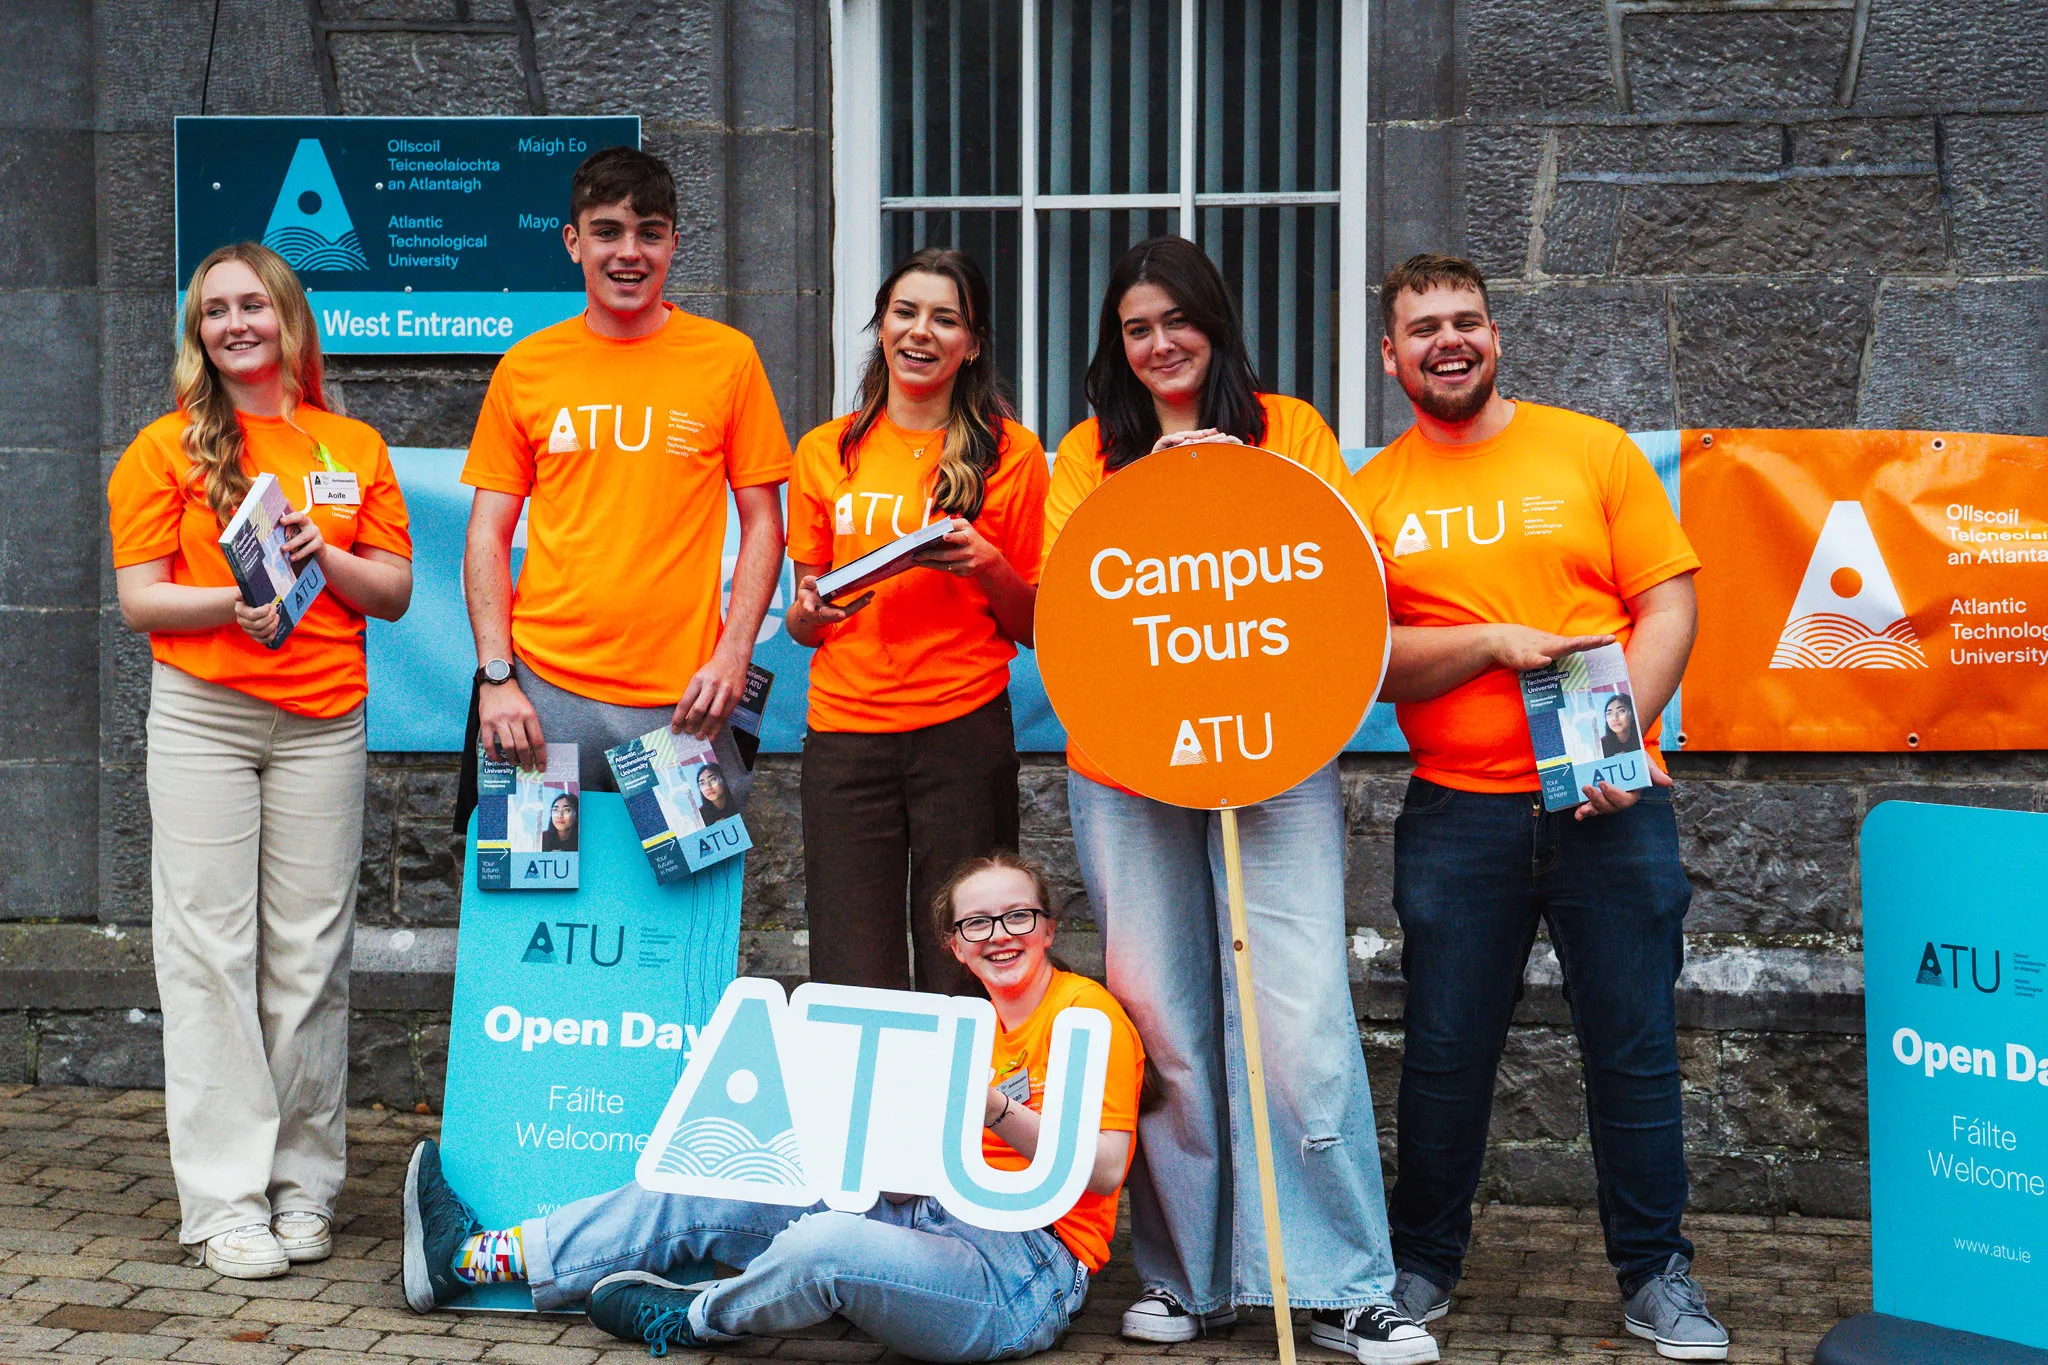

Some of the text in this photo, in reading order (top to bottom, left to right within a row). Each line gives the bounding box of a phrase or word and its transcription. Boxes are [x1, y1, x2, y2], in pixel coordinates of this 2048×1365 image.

[388, 139, 440, 153] Ollscoil
[518, 138, 587, 156] Maigh Eo
[388, 158, 500, 172] Teicneolaíochta
[388, 177, 482, 193] an Atlantaigh
[388, 215, 443, 229] Atlantic
[518, 213, 560, 232] Mayo
[389, 234, 487, 250] Technological
[389, 253, 459, 270] University
[323, 309, 513, 337] West Entrance
[548, 404, 652, 454] ATU
[835, 491, 933, 538] ATU
[1946, 503, 2019, 525] Ollscoil
[1393, 500, 1506, 558] ATU
[1089, 541, 1324, 601] Campus
[1947, 551, 1972, 566] an
[294, 569, 319, 610] ATU
[1949, 597, 2027, 615] Atlantic
[1132, 614, 1290, 667] Tours
[1950, 646, 2048, 667] University
[1526, 671, 1569, 687] Technological
[1527, 682, 1558, 694] University
[1168, 712, 1273, 768] ATU
[614, 750, 637, 764] Atlantic
[617, 750, 658, 770] Technological
[620, 762, 649, 778] University
[1592, 760, 1636, 787] ATU
[698, 824, 740, 859] ATU
[524, 859, 569, 879] ATU
[520, 921, 625, 967] ATU
[1915, 941, 2001, 994] ATU
[483, 1004, 709, 1061] Open Day
[1891, 1026, 1997, 1078] Open
[548, 1084, 625, 1115] Fáilte
[654, 997, 1091, 1212] ATU
[515, 1121, 650, 1152] Welcome
[1952, 1114, 2017, 1152] Fáilte
[1927, 1149, 2045, 1196] Welcome
[1953, 1235, 2032, 1264] www.atu.ie
